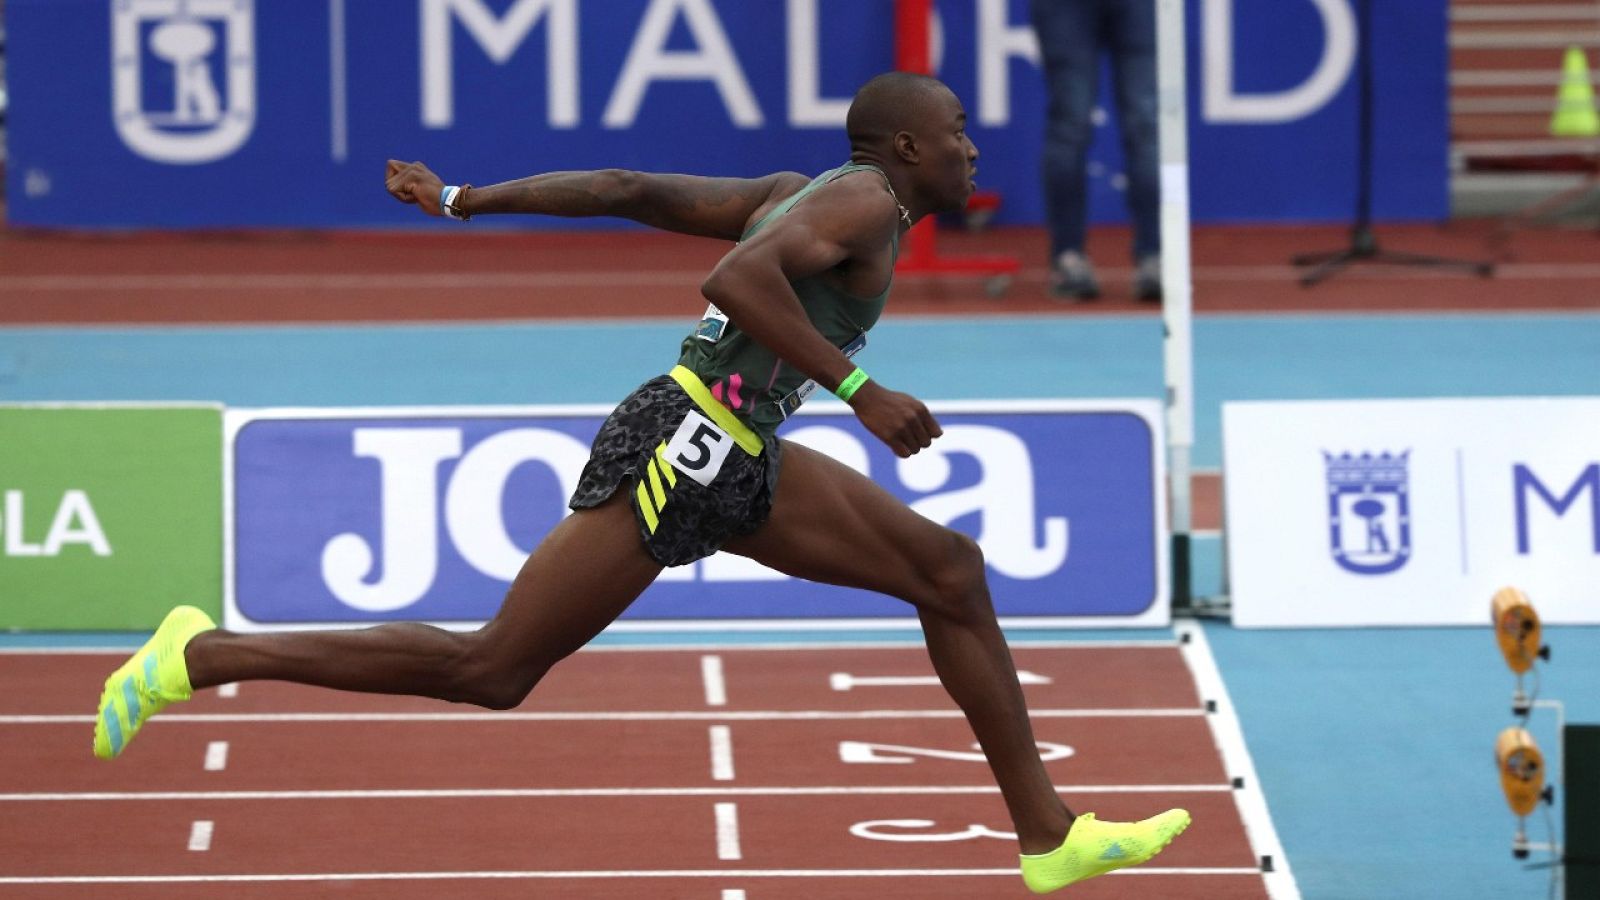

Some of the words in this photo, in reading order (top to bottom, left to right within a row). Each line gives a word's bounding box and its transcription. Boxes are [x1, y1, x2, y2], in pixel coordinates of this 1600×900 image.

[420, 0, 1358, 128] MADRD
[676, 422, 722, 470] 5
[0, 489, 112, 556] LA
[321, 425, 1068, 611] Joa
[830, 671, 1054, 692] 1
[838, 740, 1076, 764] 2
[848, 819, 1019, 842] 3
